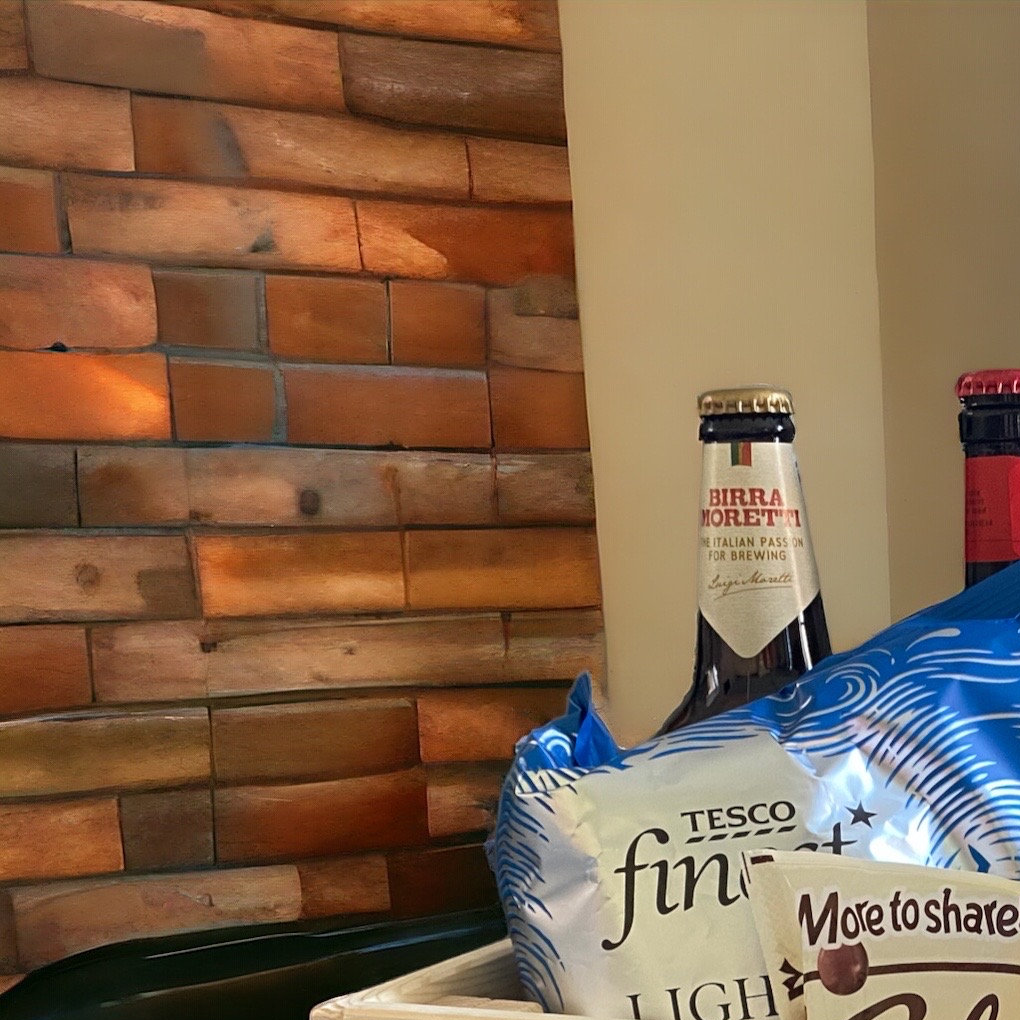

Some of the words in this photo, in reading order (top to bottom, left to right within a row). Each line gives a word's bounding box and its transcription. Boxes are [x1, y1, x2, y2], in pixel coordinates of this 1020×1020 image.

[709, 488, 784, 507] BIRRA
[702, 508, 801, 528] MORETTI
[713, 536, 755, 548] ITALIAN
[760, 536, 804, 548] PASSON
[708, 550, 726, 561] FOR
[731, 549, 787, 561] BREWING
[680, 801, 795, 832] TESCO
[601, 822, 858, 951] fint
[798, 891, 886, 946] More
[889, 891, 920, 931] to
